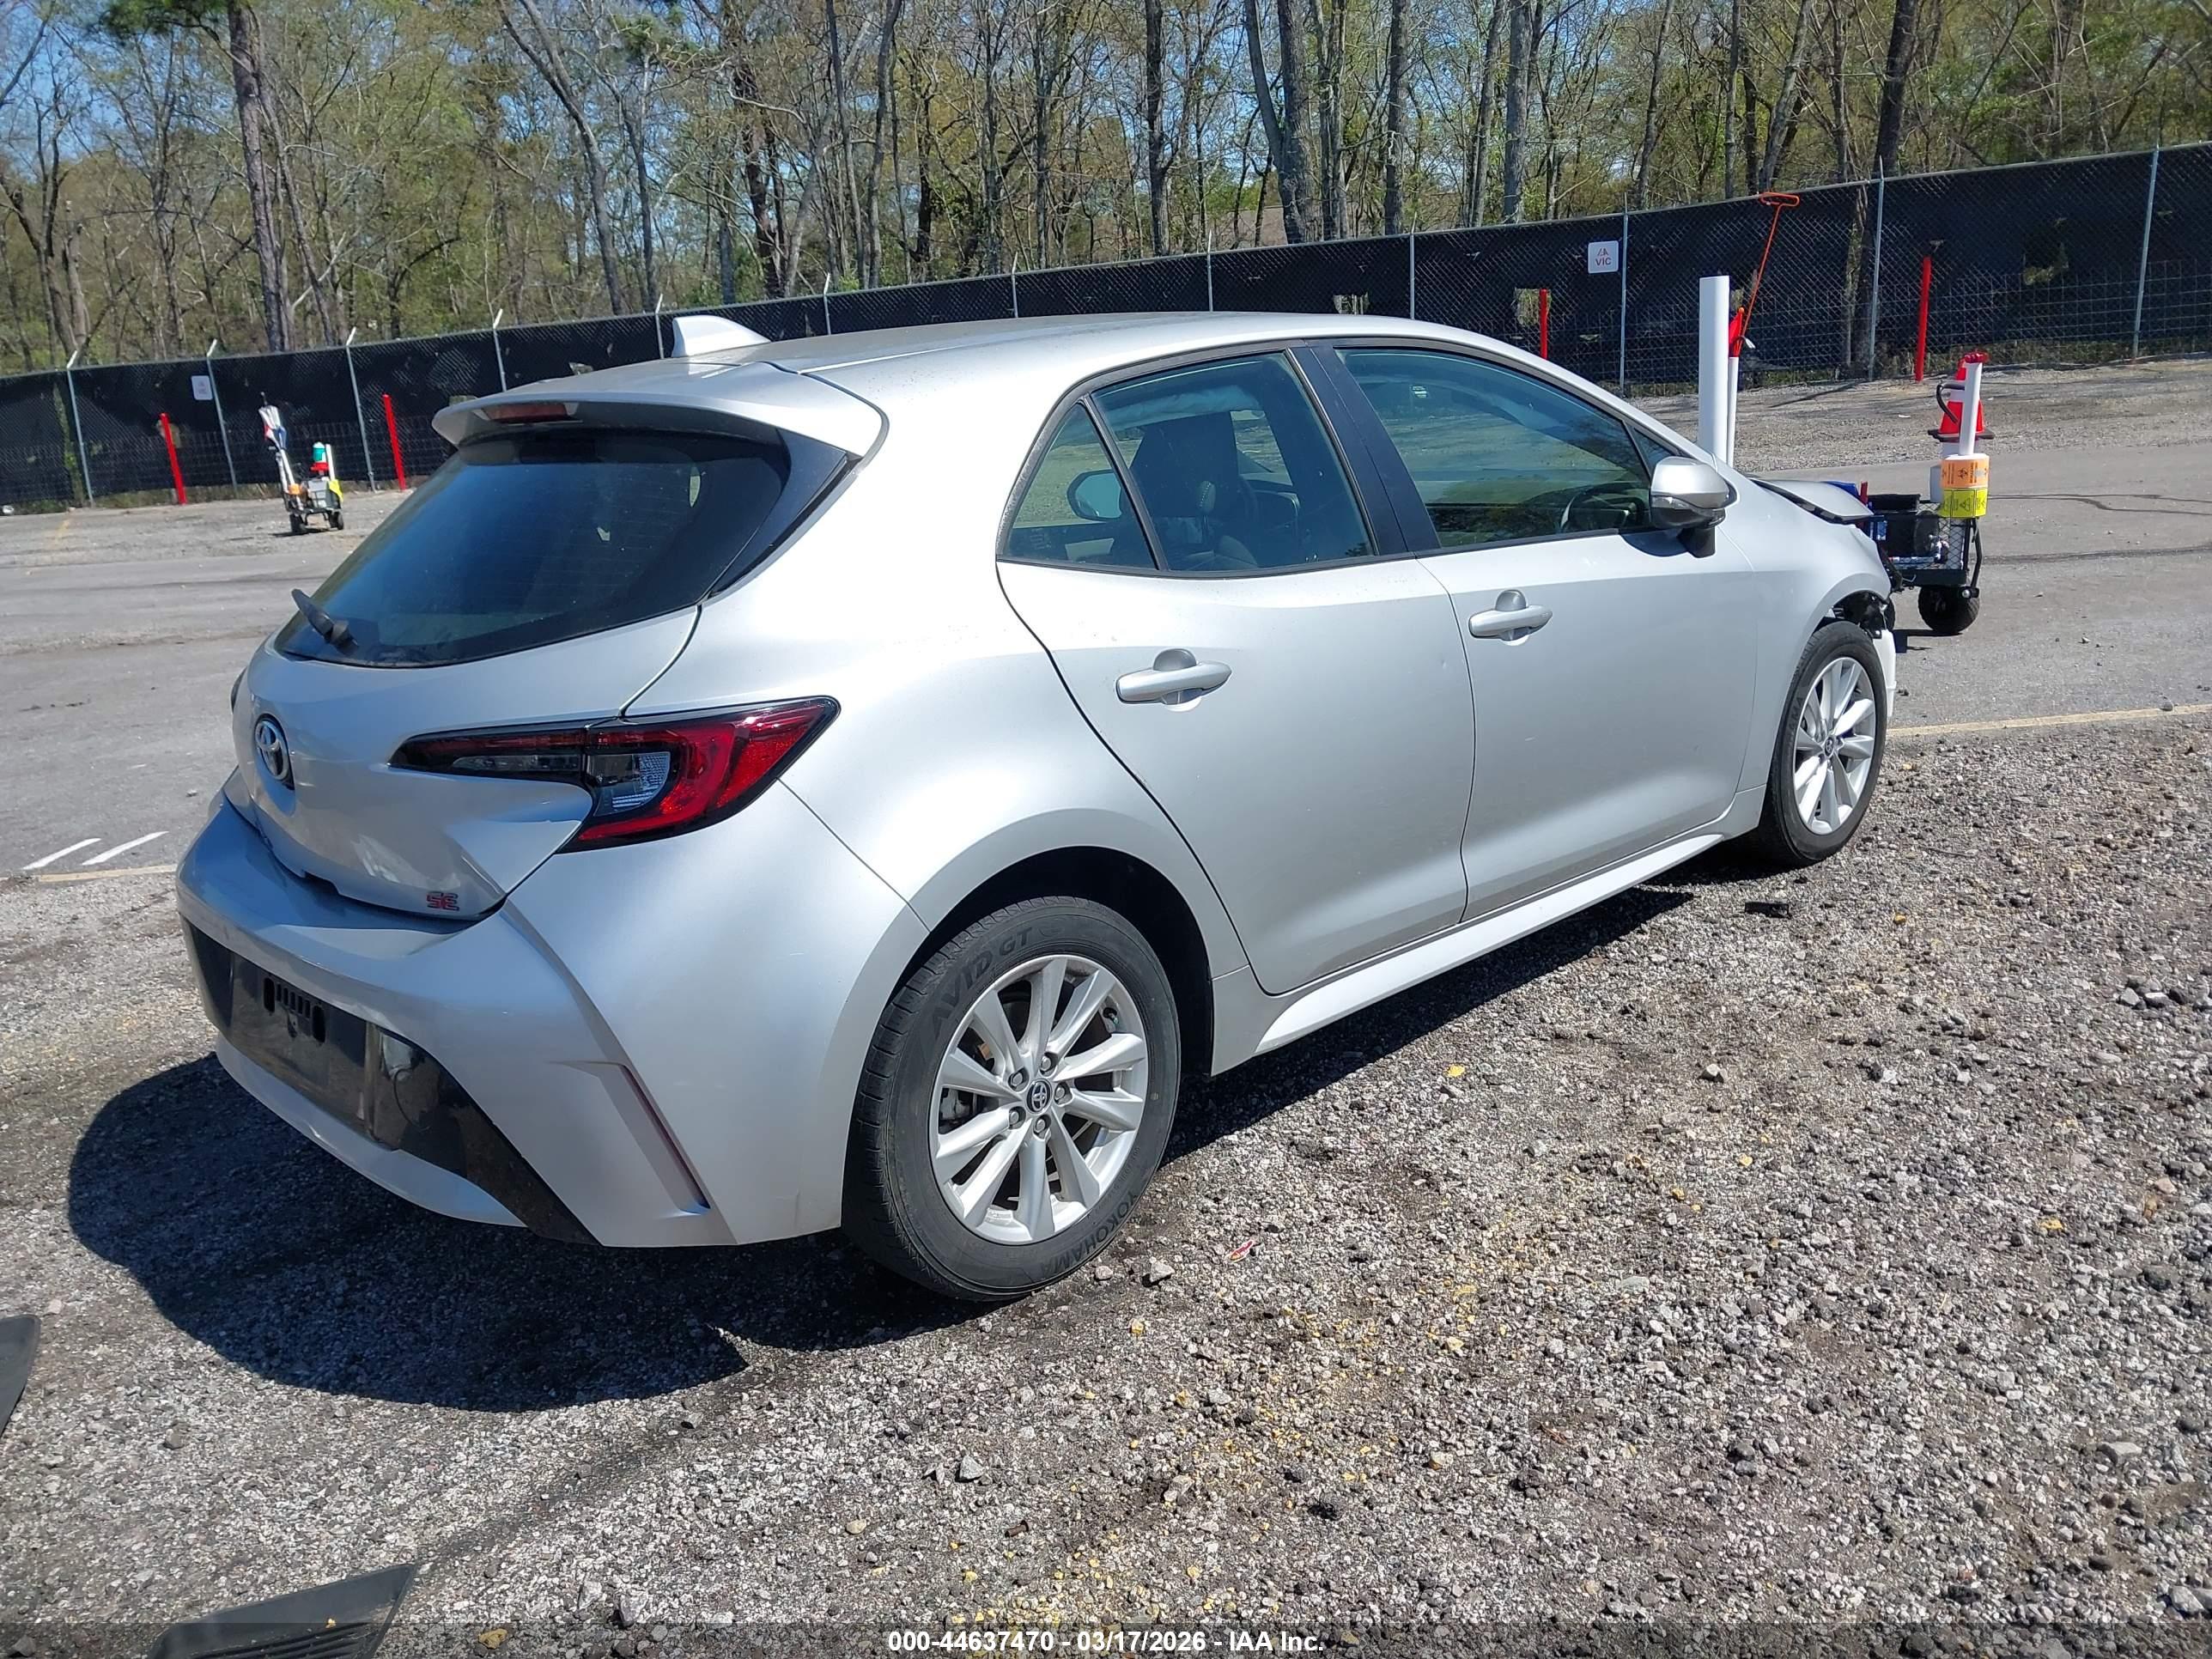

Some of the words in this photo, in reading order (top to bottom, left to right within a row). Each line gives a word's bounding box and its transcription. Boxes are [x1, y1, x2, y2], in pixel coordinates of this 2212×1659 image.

[1595, 257, 1612, 266] VIC
[426, 890, 460, 912] SE
[933, 950, 994, 1041] AVID
[999, 927, 1033, 956] GT
[1040, 1190, 1139, 1275] YOKOHAMA
